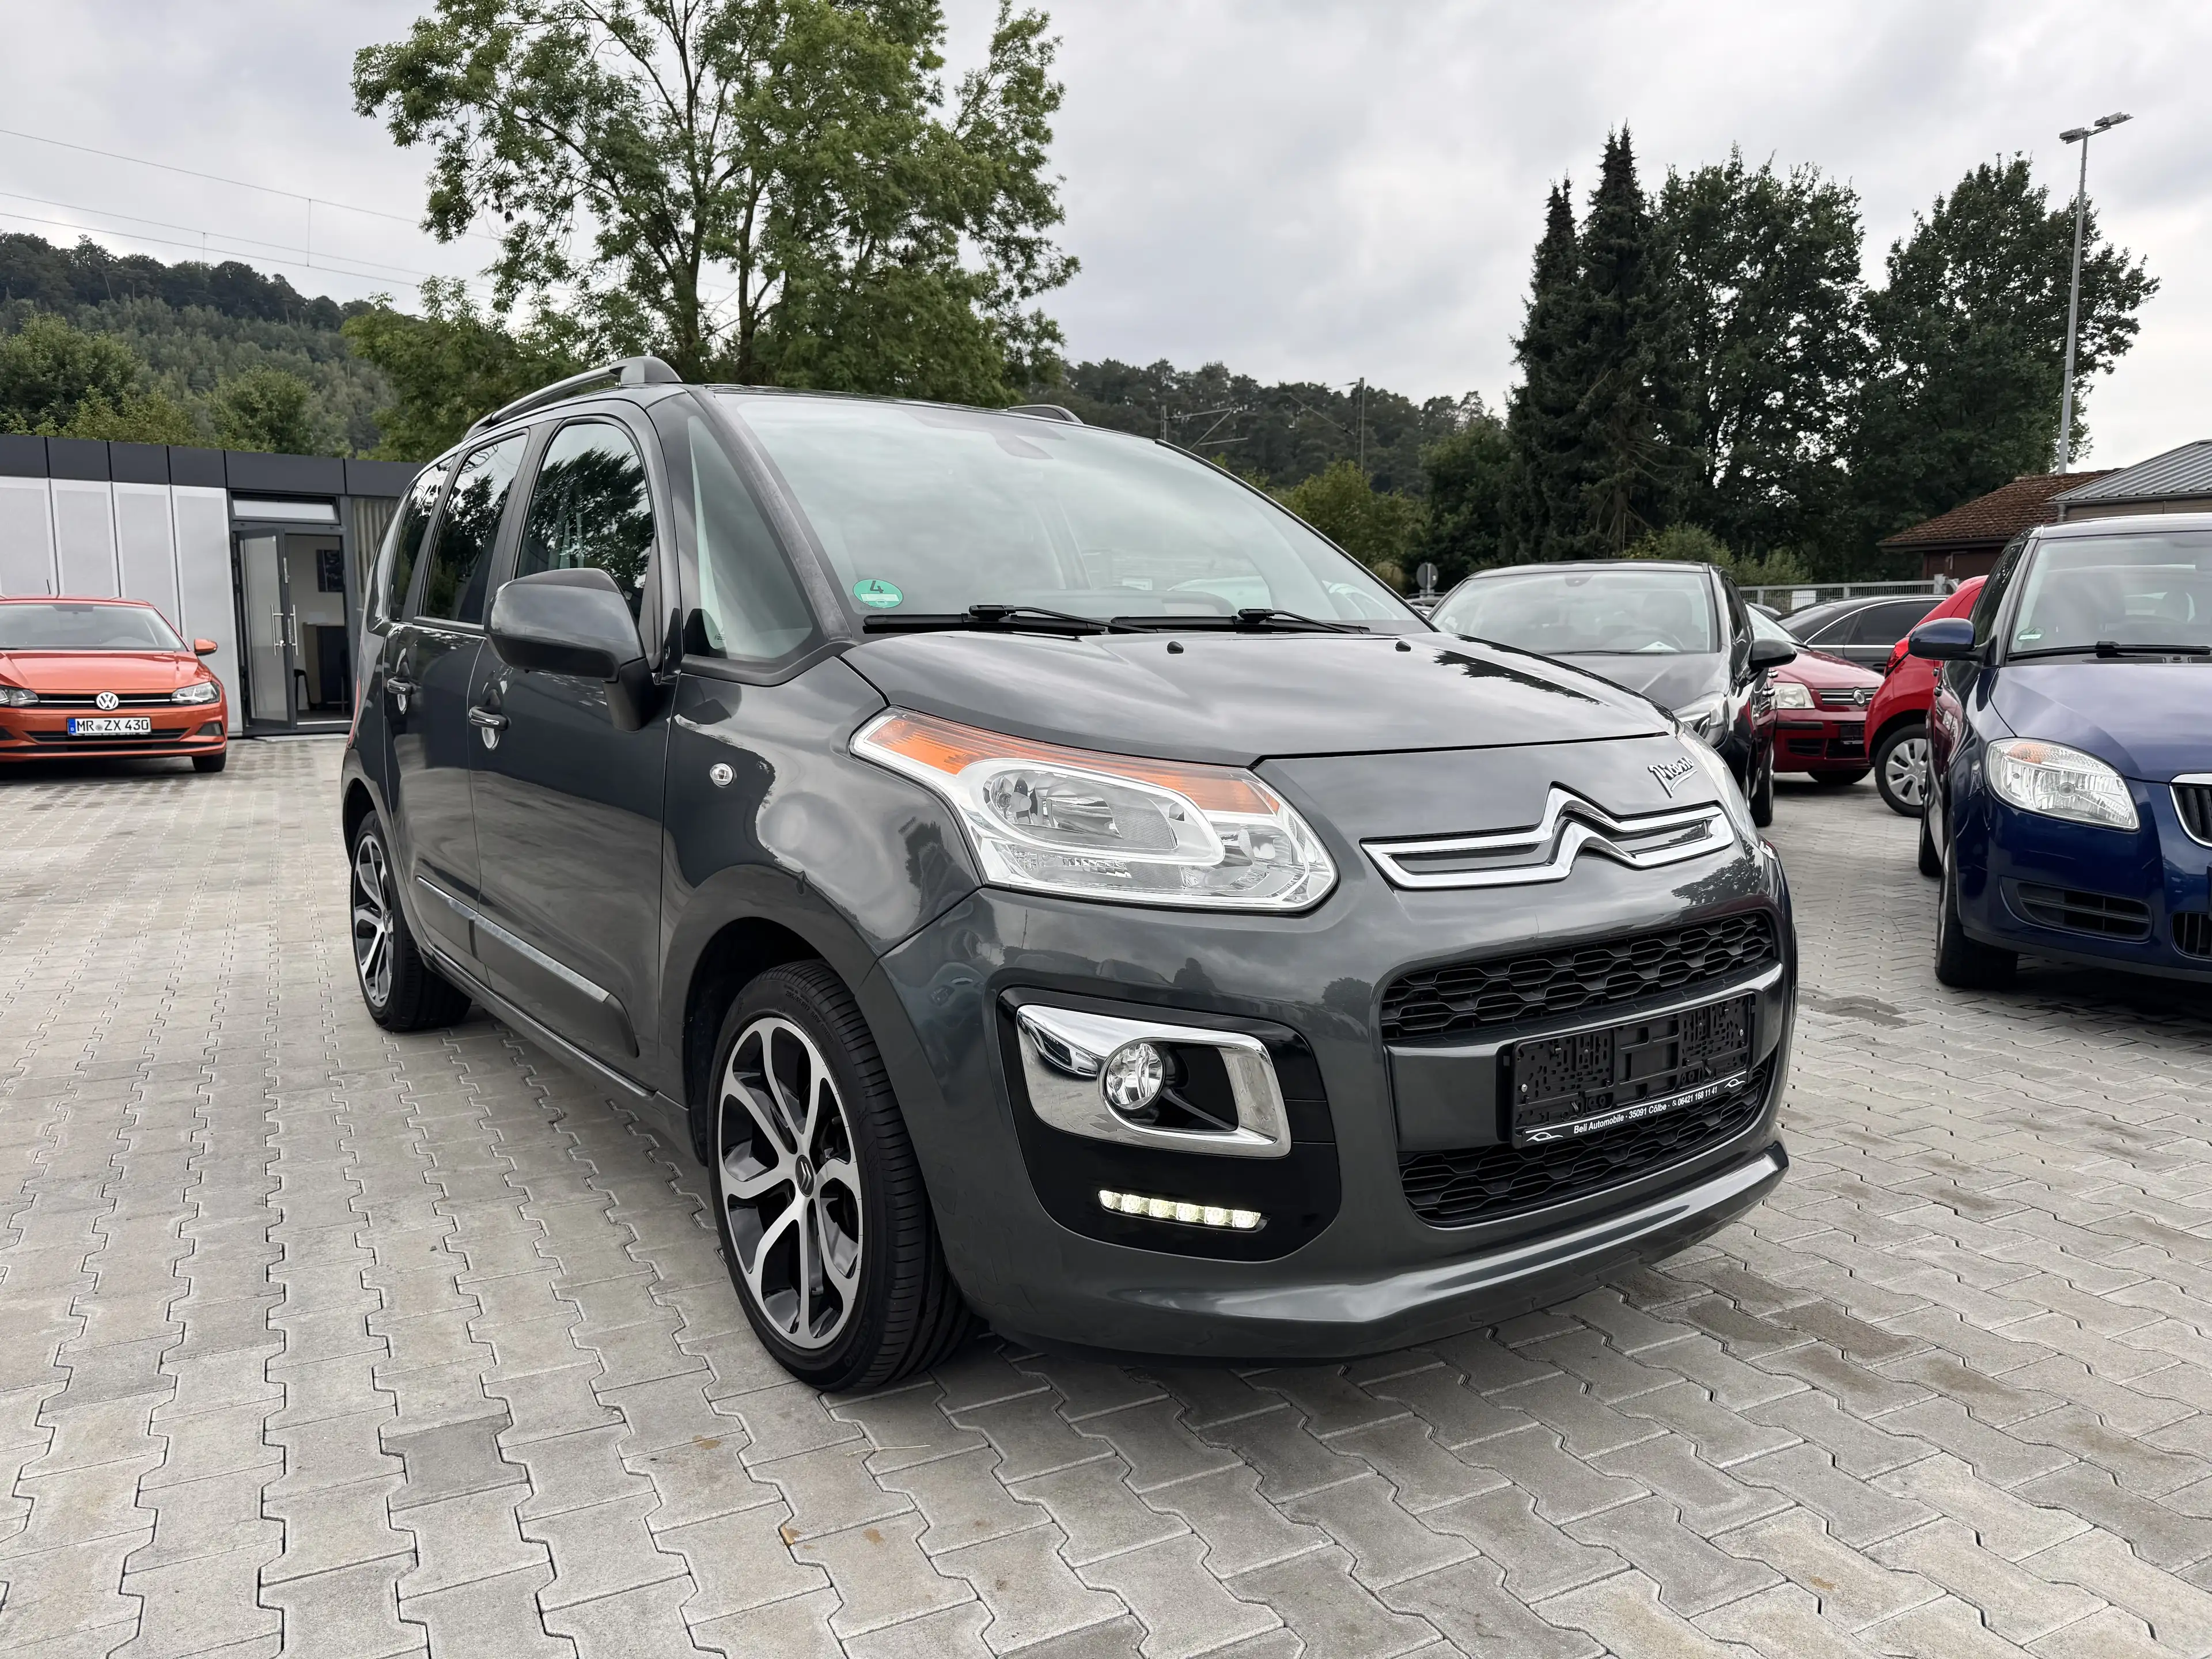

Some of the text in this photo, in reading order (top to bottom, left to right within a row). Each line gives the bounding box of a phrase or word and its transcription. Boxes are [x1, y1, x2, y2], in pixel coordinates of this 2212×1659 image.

[870, 580, 884, 593] 4
[77, 720, 94, 732] MR
[104, 719, 121, 731] ZX
[125, 719, 149, 730] 430
[1574, 1086, 1718, 1134] Beli Automobile 35091 Cölbe 06421 168 11 41
